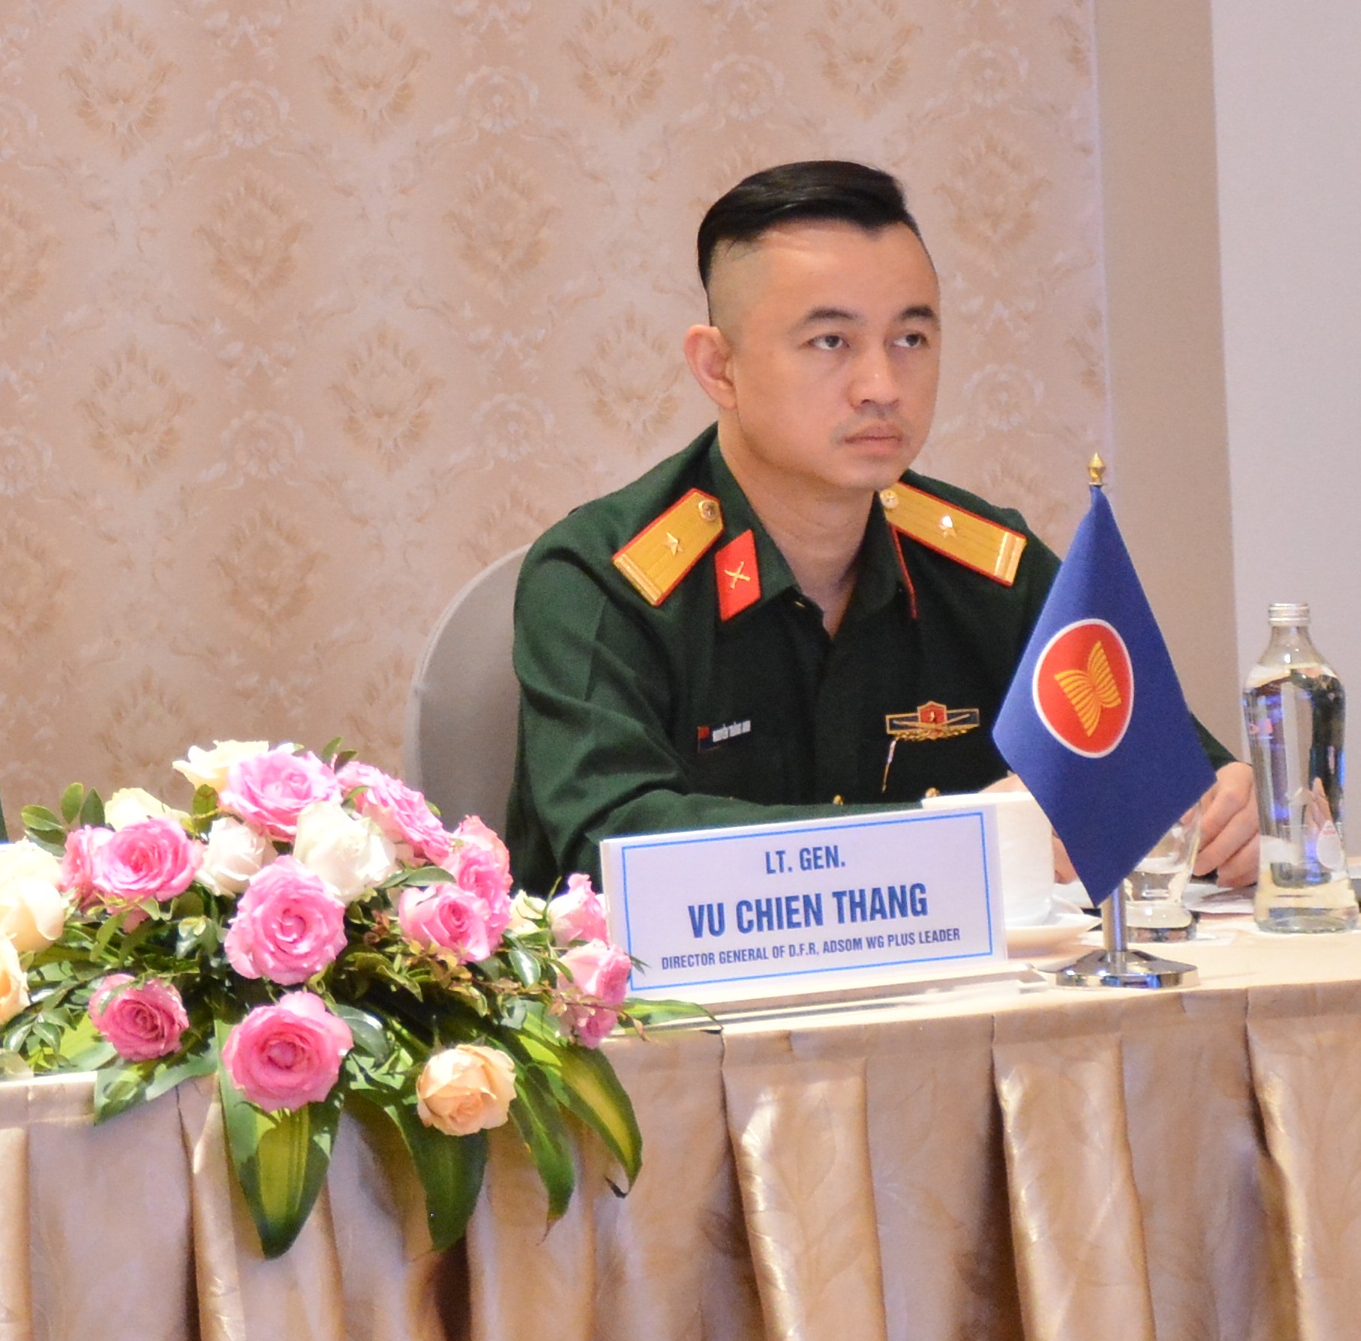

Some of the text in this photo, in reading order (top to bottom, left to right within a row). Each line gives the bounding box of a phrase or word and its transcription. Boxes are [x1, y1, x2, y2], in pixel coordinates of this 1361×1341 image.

[766, 845, 845, 874] LT. GEN.
[688, 883, 928, 938] VU CHIEN THANG
[662, 952, 715, 970] DIRECTOR
[719, 948, 769, 964] GENERAL
[772, 945, 785, 958] OF
[823, 938, 862, 953] ADSOM
[866, 935, 884, 949] WG
[887, 932, 915, 947] PLUS
[919, 928, 960, 944] LEADER
